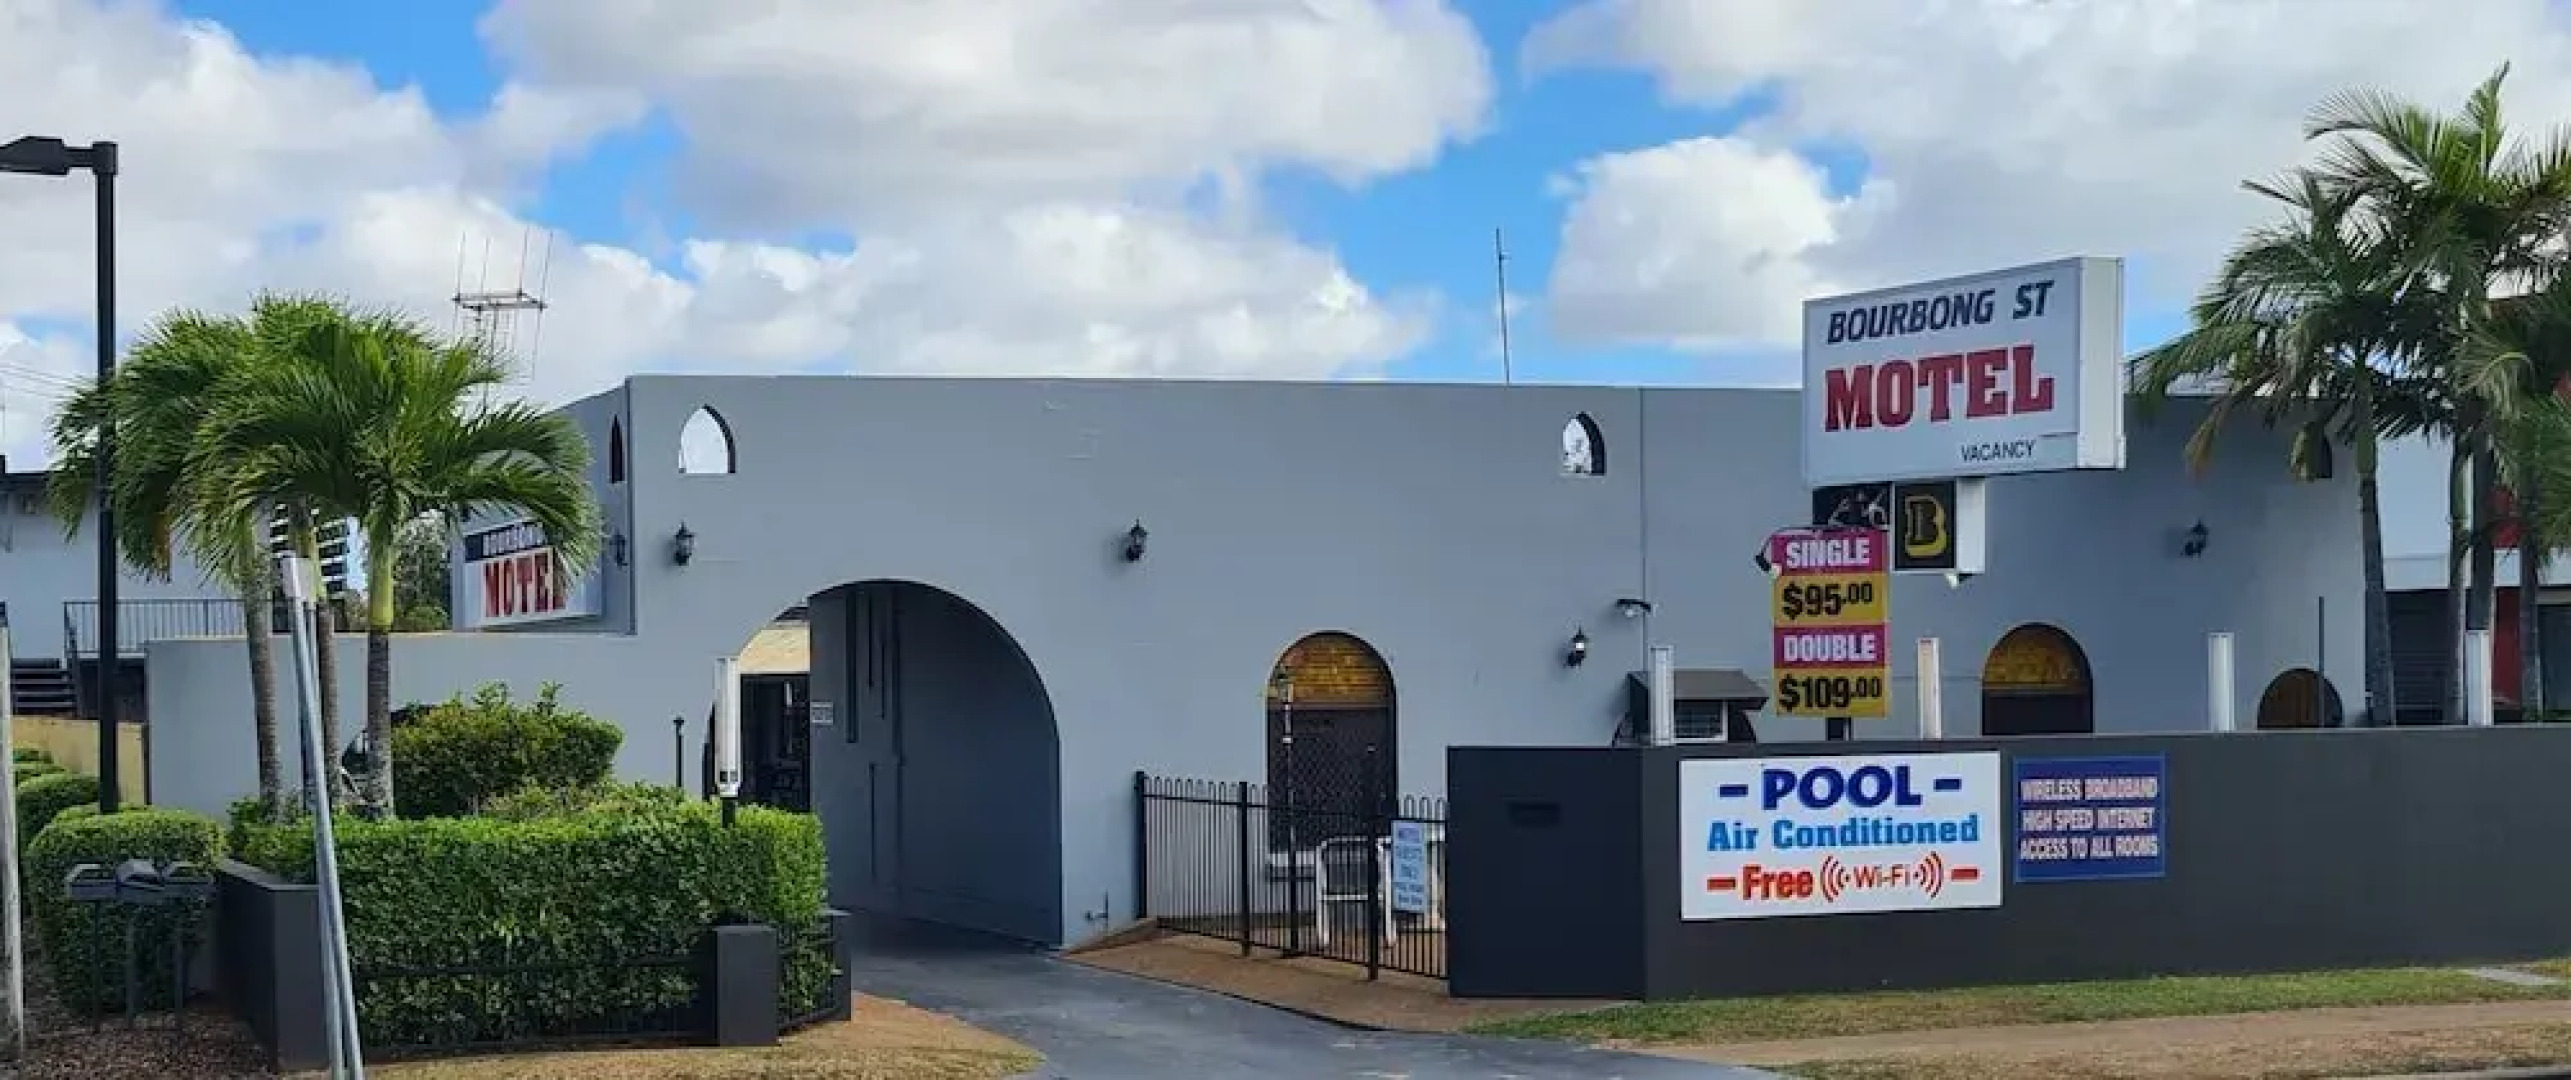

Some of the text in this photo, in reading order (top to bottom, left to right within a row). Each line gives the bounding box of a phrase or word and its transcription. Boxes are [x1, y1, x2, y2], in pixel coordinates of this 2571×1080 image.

[1827, 280, 2055, 345] BOURBONG ST
[1825, 345, 2055, 432] MOTEL
[1961, 439, 2037, 463] VACANCY
[1903, 495, 1948, 558] B
[1786, 538, 1870, 569] SINGLE
[1782, 580, 1873, 620] $95.00
[1783, 634, 1877, 663] DOUBLE
[1778, 674, 1882, 712] $109.00
[1761, 764, 1923, 811] POOL
[2020, 778, 2081, 802] WIRELESS
[1707, 814, 1980, 851] Air Conditioned
[2020, 807, 2156, 832] HIGH SPEED INTERNET
[2020, 835, 2158, 860] ACCESS TO ALL ROOMS
[1742, 863, 1911, 901] Free Wi-Fi
